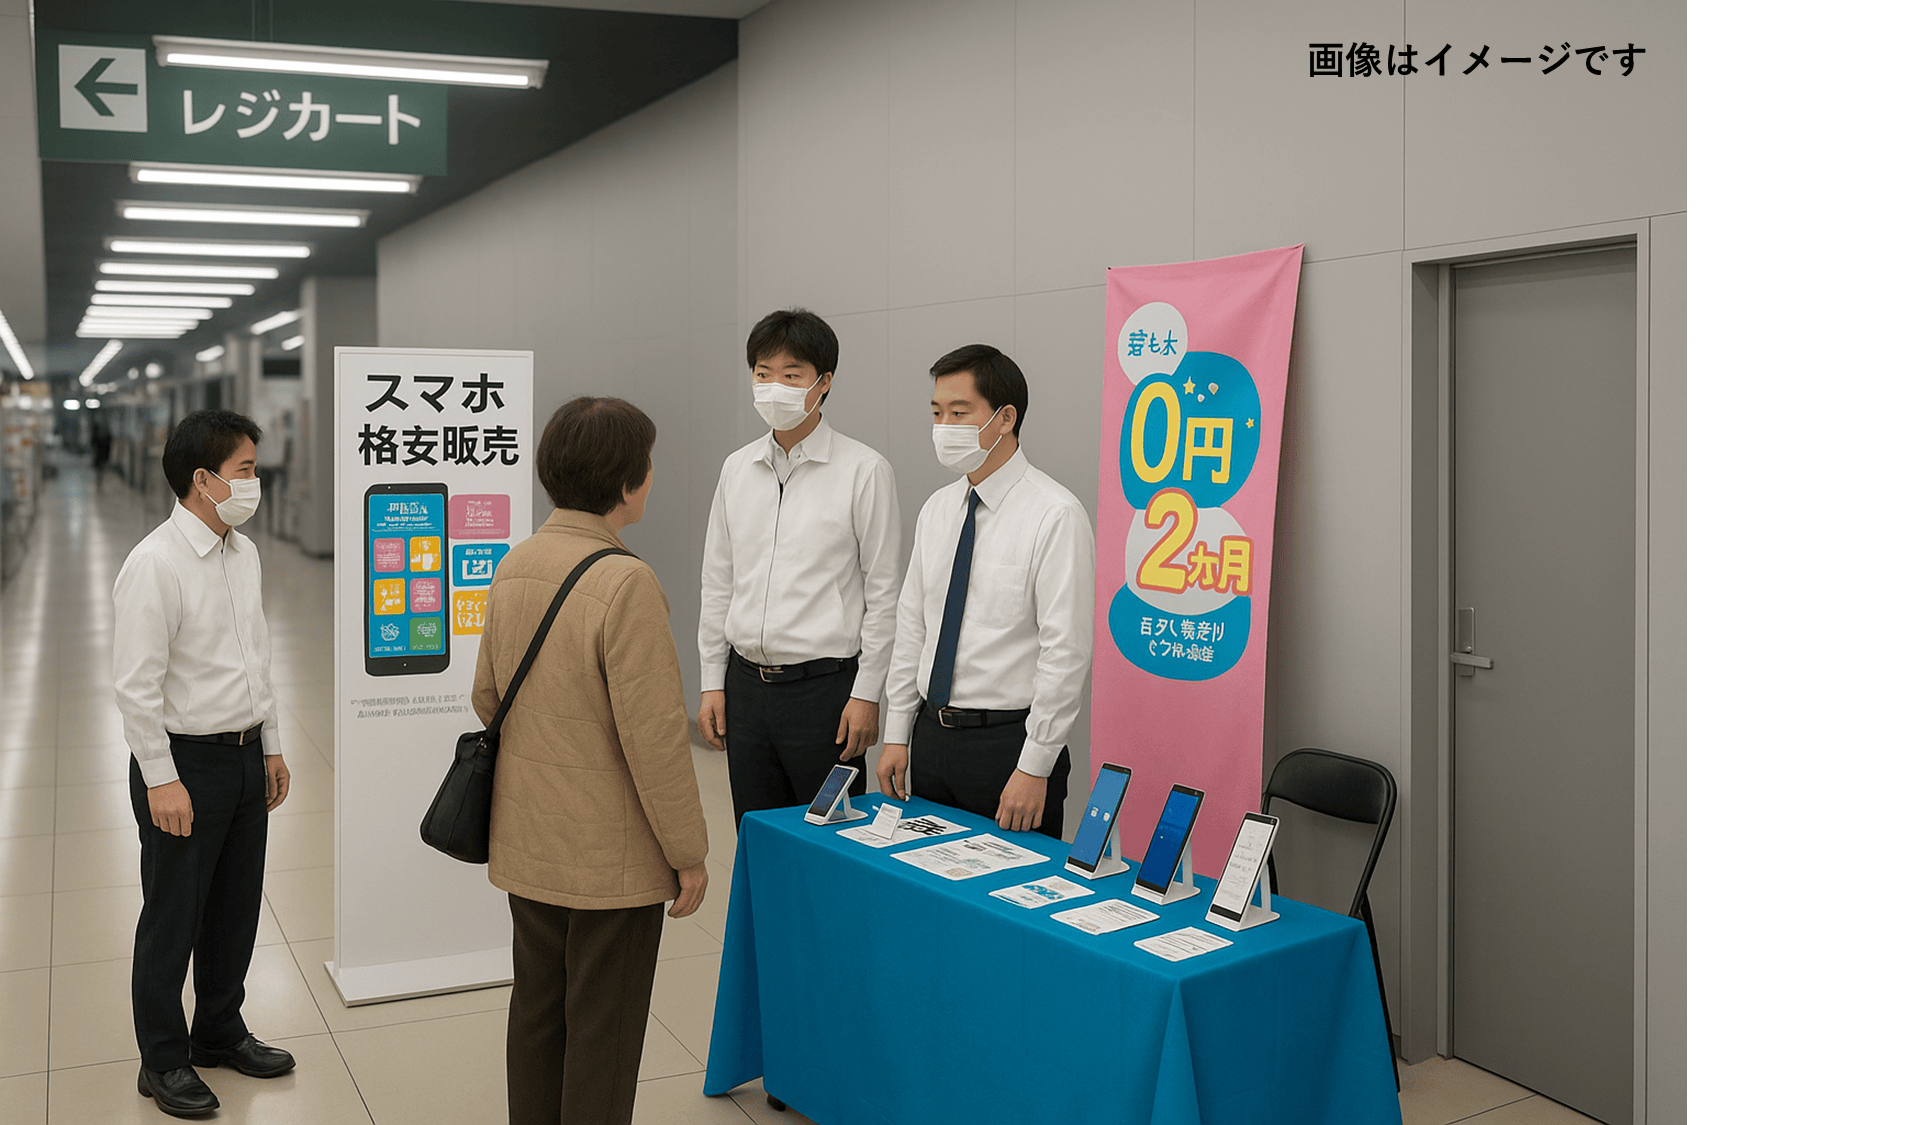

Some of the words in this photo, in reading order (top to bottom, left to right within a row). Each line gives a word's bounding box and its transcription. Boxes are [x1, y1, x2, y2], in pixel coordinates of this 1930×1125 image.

[182, 89, 421, 146] レジカート
[365, 373, 505, 413] スマホ
[358, 424, 519, 466] 格安販売
[1131, 381, 1234, 483] 0円
